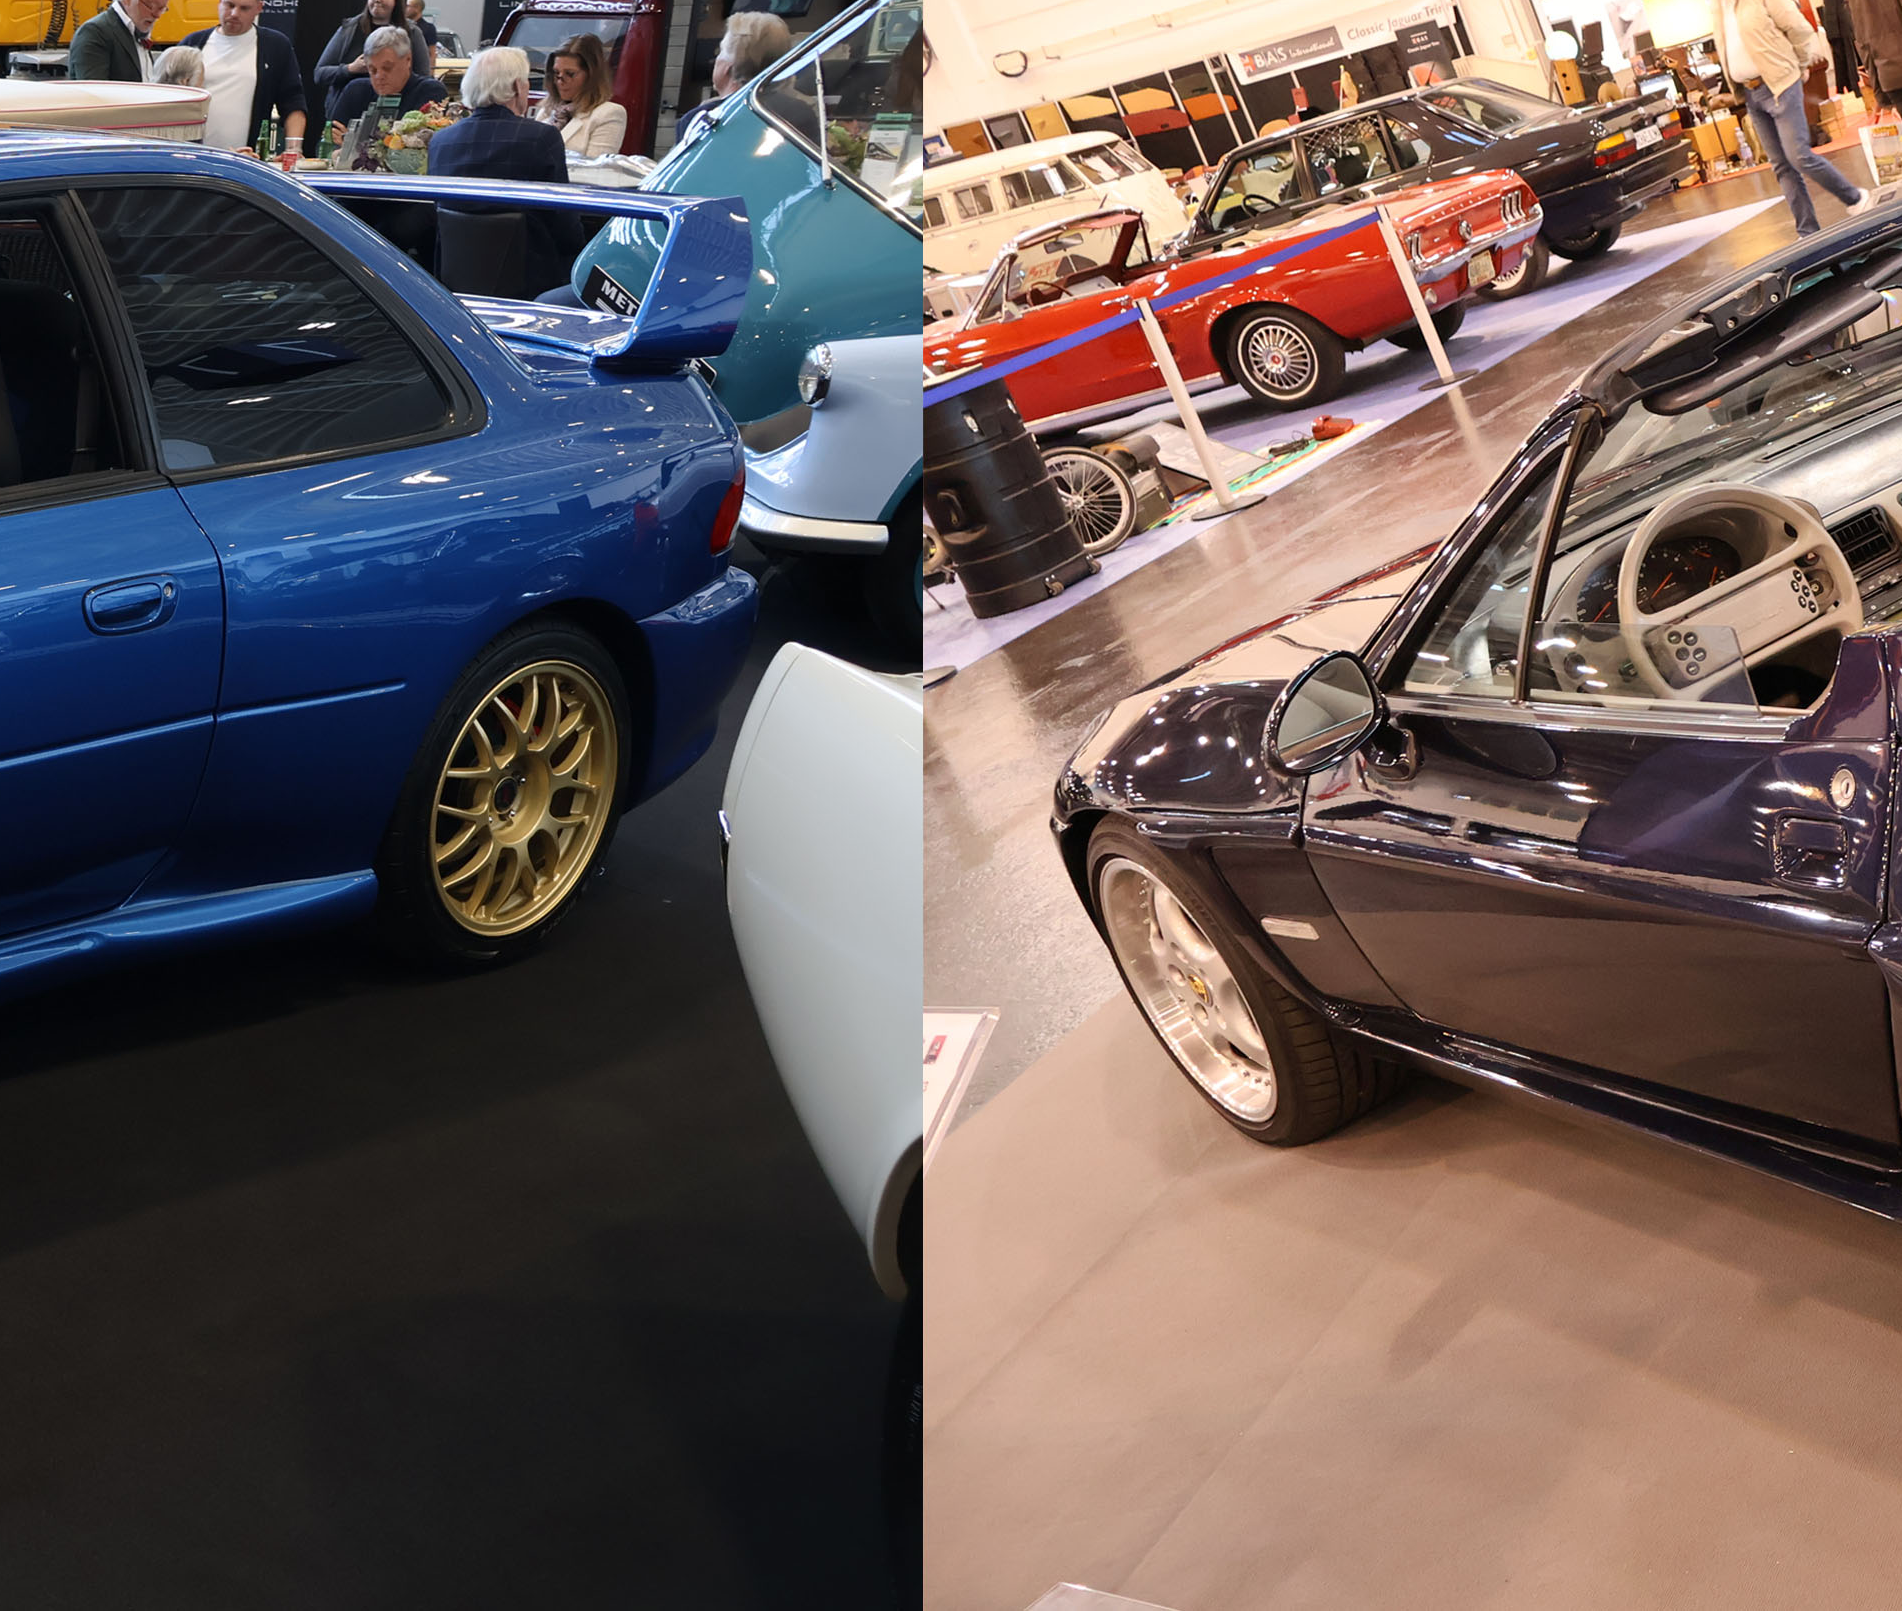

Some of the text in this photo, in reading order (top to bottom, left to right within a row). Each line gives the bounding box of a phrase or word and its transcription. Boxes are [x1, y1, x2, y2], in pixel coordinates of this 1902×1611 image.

[1346, 22, 1384, 41] Classic
[1387, 9, 1423, 31] Jaguar
[1288, 36, 1336, 59] International
